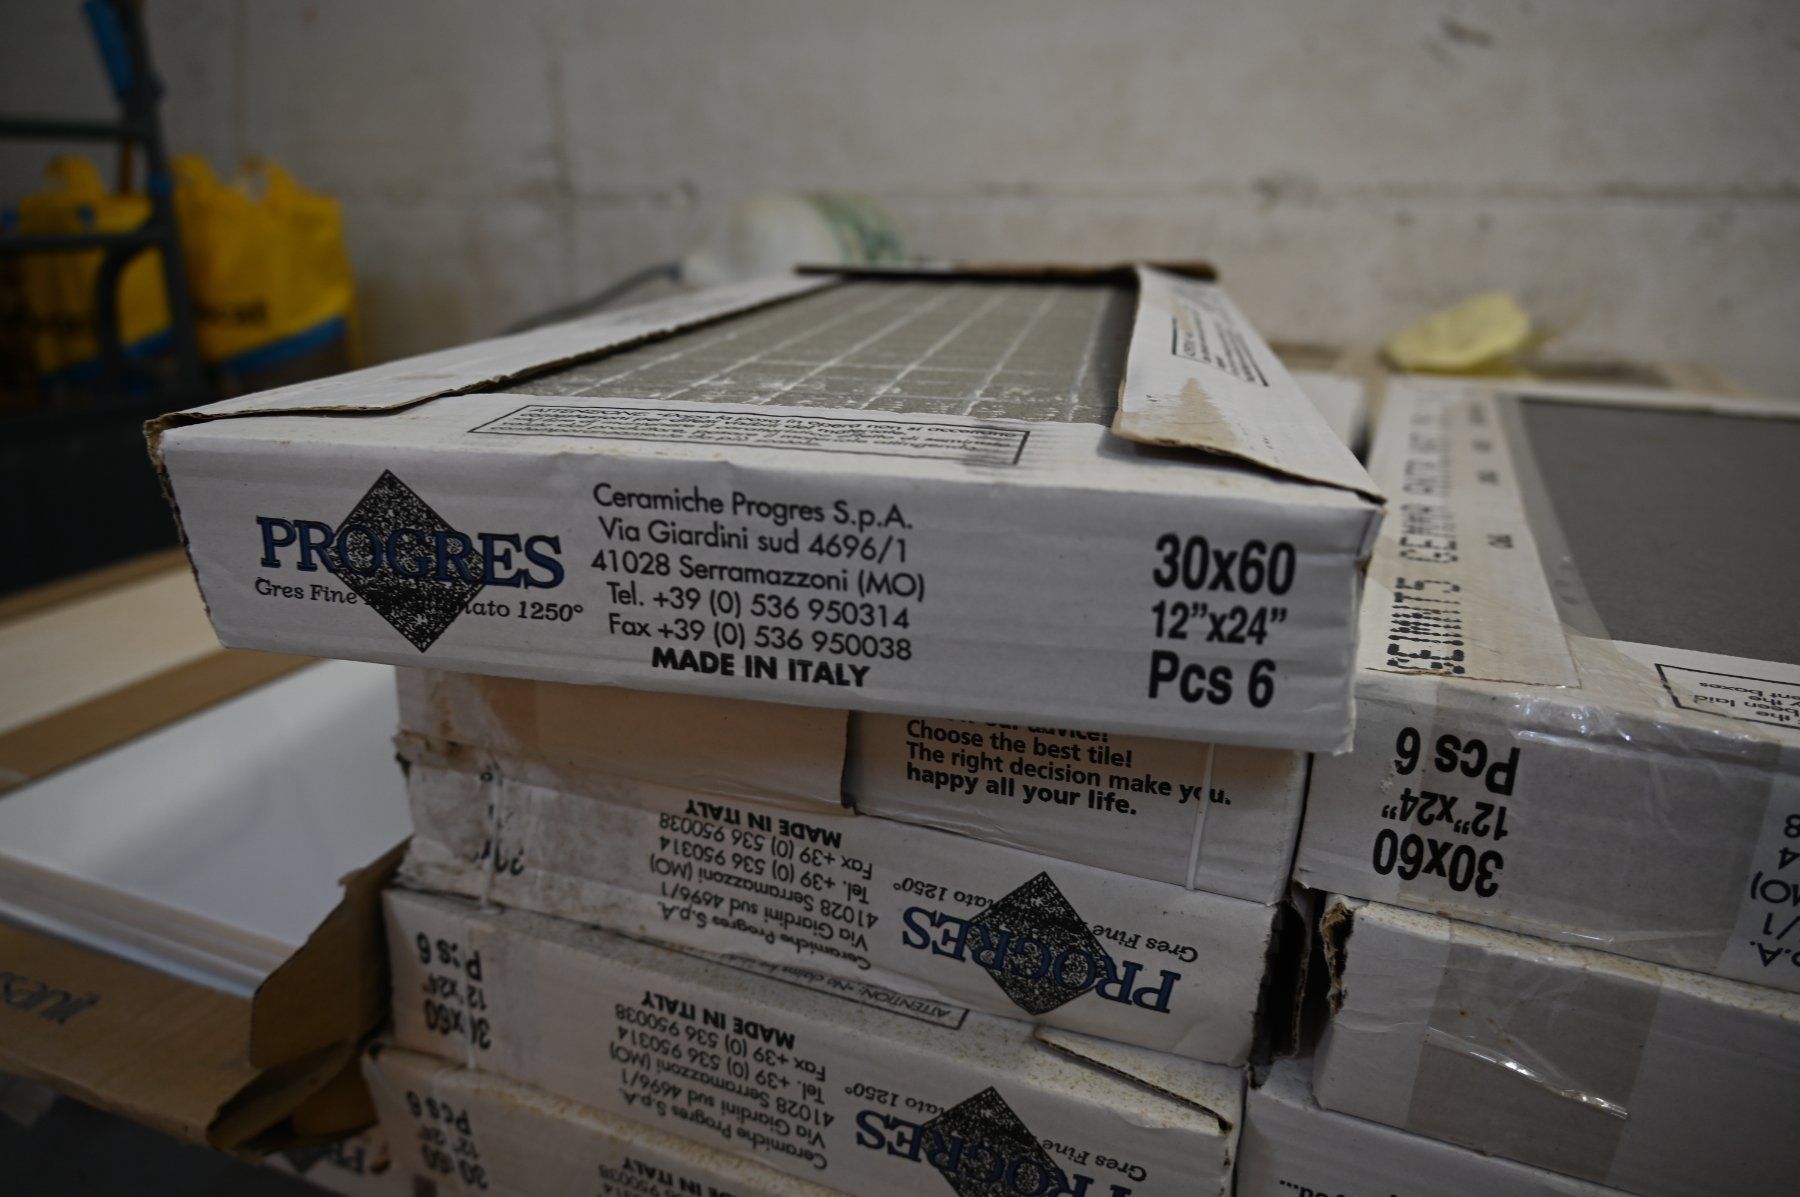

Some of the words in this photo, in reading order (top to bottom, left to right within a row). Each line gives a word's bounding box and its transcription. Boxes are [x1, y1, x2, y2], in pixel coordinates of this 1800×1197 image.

[592, 481, 725, 515] Ceramiche
[731, 490, 826, 527] Progres
[832, 499, 914, 532] S.p.A.
[255, 515, 566, 590] PROGRES
[598, 515, 641, 542] Via
[647, 519, 750, 551] Giardini
[757, 527, 800, 555] sud
[807, 532, 908, 565] 4696/1
[590, 548, 671, 577] 41028
[678, 554, 850, 593] Serramazzoni
[856, 568, 926, 603] (MO)
[1153, 531, 1296, 596] 30x60
[254, 576, 306, 600] Gres
[308, 584, 359, 605] Fine
[516, 600, 585, 623] 1250°
[606, 580, 645, 607] Tel.
[652, 586, 702, 610] +39
[708, 588, 743, 619] (0)
[749, 593, 800, 621] 536
[807, 598, 911, 630] 950314
[607, 612, 652, 638] Fax
[656, 618, 705, 642] +39
[713, 620, 746, 651] (0)
[753, 625, 804, 652] 536
[811, 630, 913, 662] 950038
[1151, 599, 1288, 646] 12”x24”
[651, 646, 736, 678] MADE
[744, 653, 778, 680] IN
[787, 658, 871, 688] ITALY
[1147, 649, 1233, 706] Pcs
[1247, 657, 1277, 709] 6
[1693, 694, 1736, 708] laid
[1698, 682, 1764, 697] boxes
[906, 718, 984, 747] Choose
[990, 731, 1027, 754] the
[1032, 736, 1081, 762] best
[1086, 741, 1133, 768] tile!
[1394, 726, 1421, 776] 6
[906, 741, 945, 764] The
[950, 747, 1004, 775] right
[1009, 752, 1101, 788] decision
[1108, 771, 1173, 798] make
[1434, 733, 1521, 796] Pcs
[906, 762, 979, 795] happy
[985, 776, 1015, 798] all
[1021, 784, 1082, 805] your
[1087, 789, 1138, 816] life.
[658, 811, 726, 844] 950038
[684, 798, 741, 826] ITALY
[747, 811, 773, 833] IN
[1381, 787, 1509, 841] 12”x24”
[731, 828, 766, 853] 536
[770, 835, 795, 861] (0)
[778, 818, 843, 850] MADE
[659, 834, 727, 867] 950314
[732, 851, 767, 876] 536
[799, 847, 837, 869] +39
[1372, 828, 1504, 898] 30x60
[649, 852, 694, 883] (MO)
[772, 858, 796, 885] (0)
[799, 871, 837, 892] +39
[840, 854, 873, 881] Fax
[660, 880, 725, 911] 4696/1
[697, 866, 815, 914] Serramazzoni
[842, 880, 870, 906] Tel.
[892, 875, 946, 903] 1250°
[656, 899, 708, 930] S.p.A.
[728, 896, 759, 918] sud
[763, 905, 836, 941] Giardini
[820, 898, 879, 931] 41028
[712, 913, 776, 945] Progres
[838, 927, 871, 952] Via
[1092, 923, 1143, 950] Fine
[416, 931, 432, 965] 6
[779, 932, 873, 972] Ceramiche
[901, 905, 1182, 1015] PROGRES
[1145, 936, 1199, 964] Gres
[641, 990, 696, 1021] ITALY
[855, 984, 952, 1020] ATTENTION:
[614, 1002, 681, 1038] 950038
[702, 1008, 727, 1030] IN
[732, 1015, 796, 1051] MADE
[617, 1024, 683, 1061] 950314
[684, 1024, 720, 1050] 536
[724, 1032, 749, 1059] (0)
[609, 1040, 652, 1072] (MO)
[687, 1047, 722, 1072] 536
[726, 1055, 750, 1082] (0)
[752, 1046, 790, 1068] +39
[793, 1055, 827, 1083] Fax
[621, 1068, 683, 1101] 4696/1
[656, 1057, 771, 1109] Serramazzoni
[755, 1068, 791, 1091] +39
[797, 1079, 826, 1105] Tel.
[844, 1081, 901, 1108] 1250°
[406, 1089, 422, 1119] 6
[687, 1089, 716, 1108] sud
[775, 1095, 836, 1129] 41028
[671, 1103, 732, 1140] Progres
[720, 1098, 792, 1137] Giardini
[736, 1127, 829, 1171] Ceramiche
[795, 1124, 827, 1150] Via
[1042, 1139, 1092, 1167] Fine
[623, 1156, 674, 1187] ITALY
[1095, 1153, 1148, 1183] Gres
